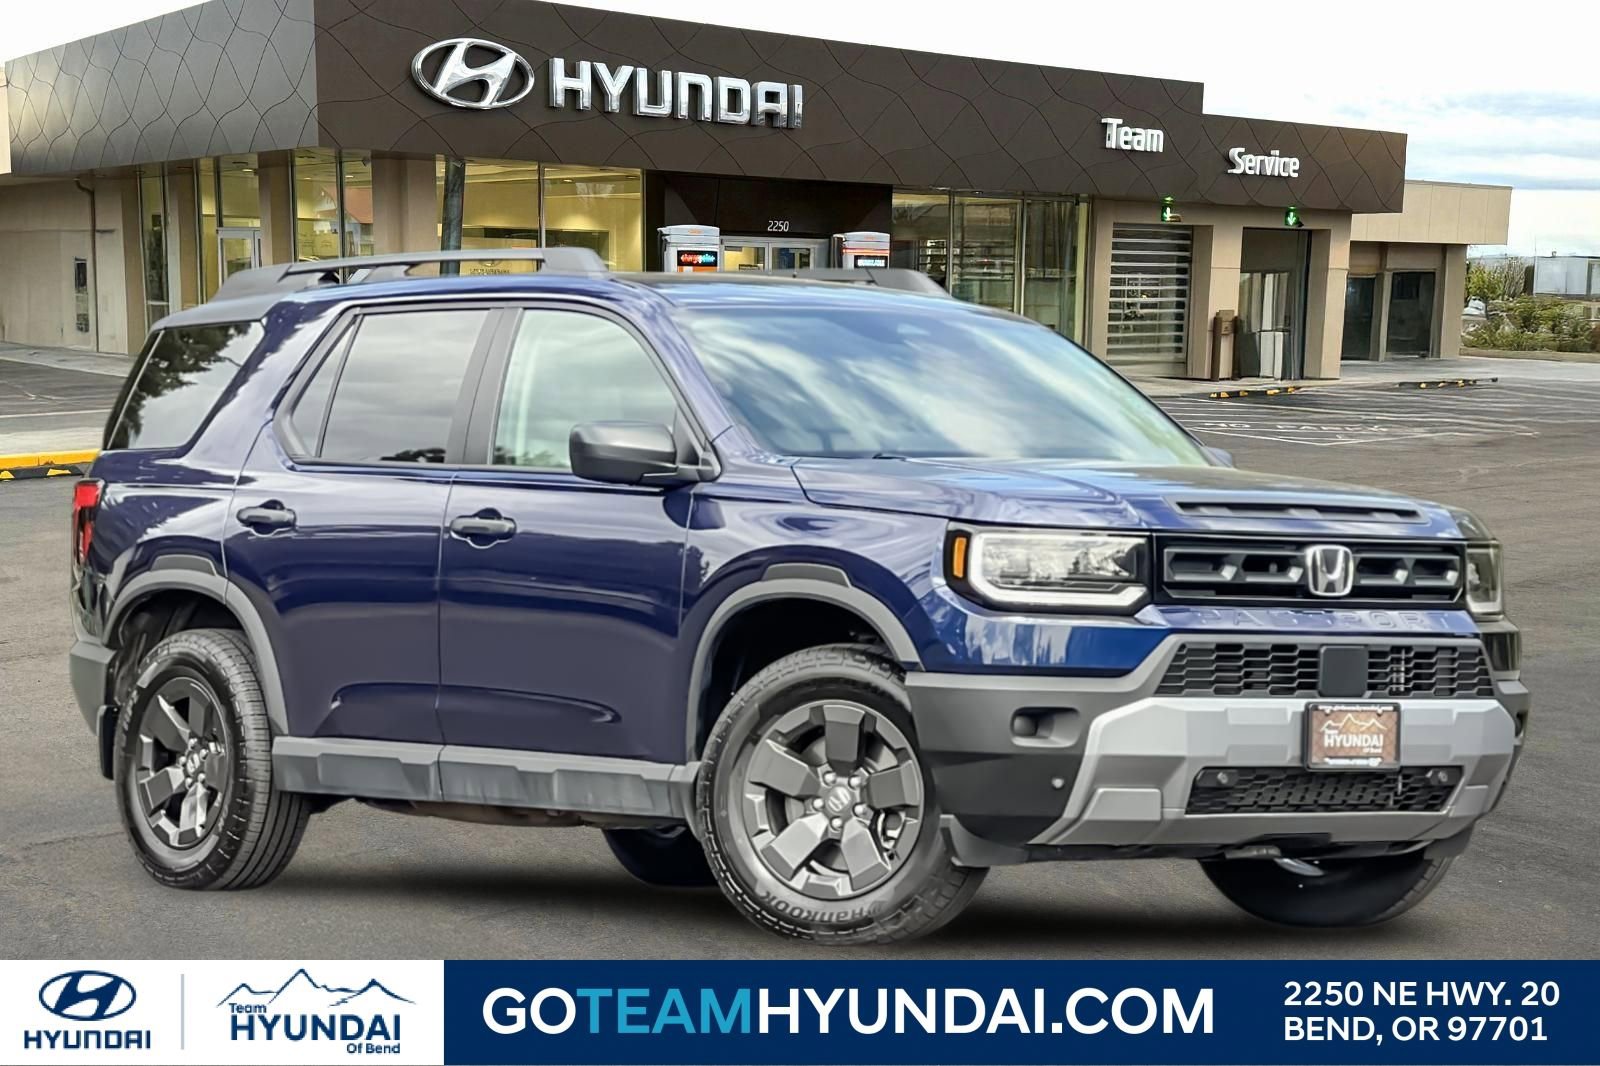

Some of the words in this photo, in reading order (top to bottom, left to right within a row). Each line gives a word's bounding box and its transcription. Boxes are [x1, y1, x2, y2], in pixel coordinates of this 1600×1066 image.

[549, 57, 803, 129] HYUNDAI
[1101, 117, 1164, 153] Team
[1227, 147, 1300, 178] Service
[767, 220, 790, 232] 2250
[1324, 733, 1384, 749] HYUNDAI
